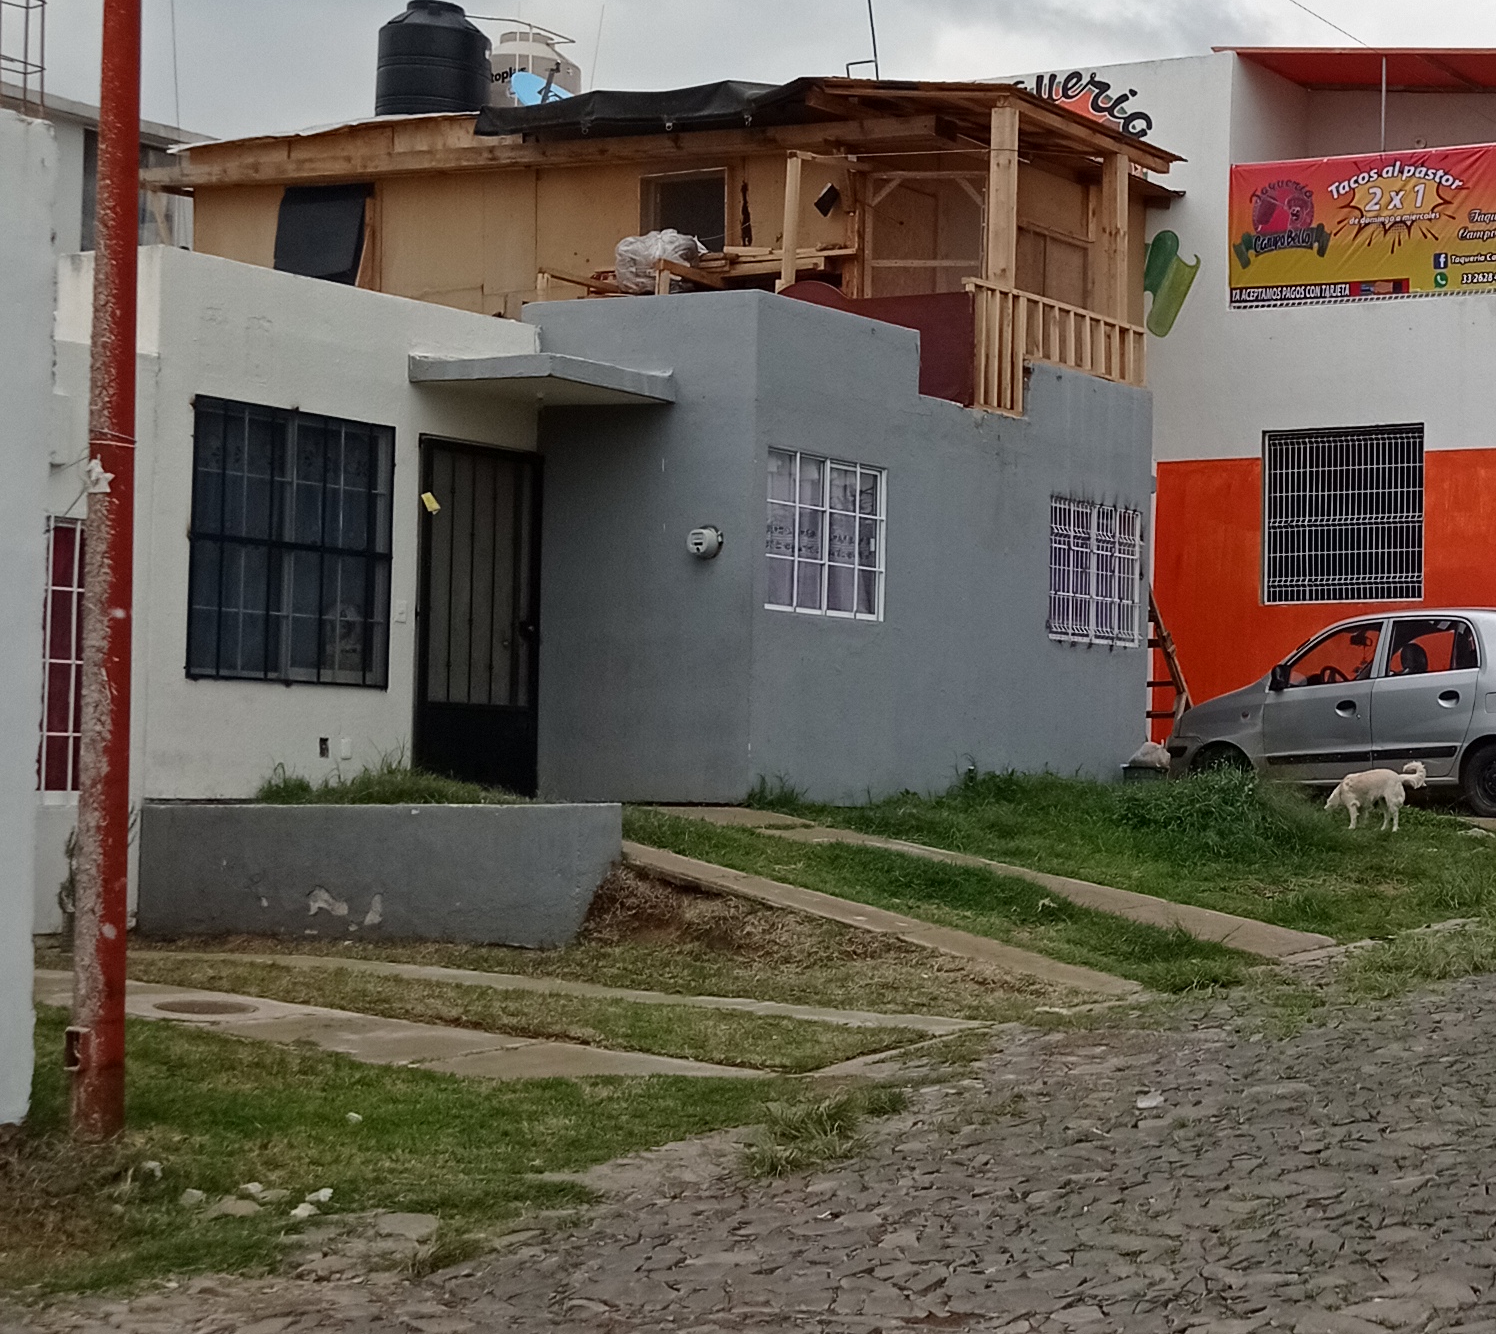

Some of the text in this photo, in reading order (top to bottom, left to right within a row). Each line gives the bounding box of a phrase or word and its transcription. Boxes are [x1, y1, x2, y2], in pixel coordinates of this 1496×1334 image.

[1327, 160, 1463, 199] Tacos al pastor
[1364, 183, 1426, 211] 2 x 1
[1349, 216, 1359, 225] de
[1360, 215, 1395, 224] domingo
[1253, 228, 1311, 254] Campo Bello
[1451, 253, 1484, 264] Taqueria
[1232, 283, 1350, 301] YA ACEPTAMOS PAGOS CON TARJETA
